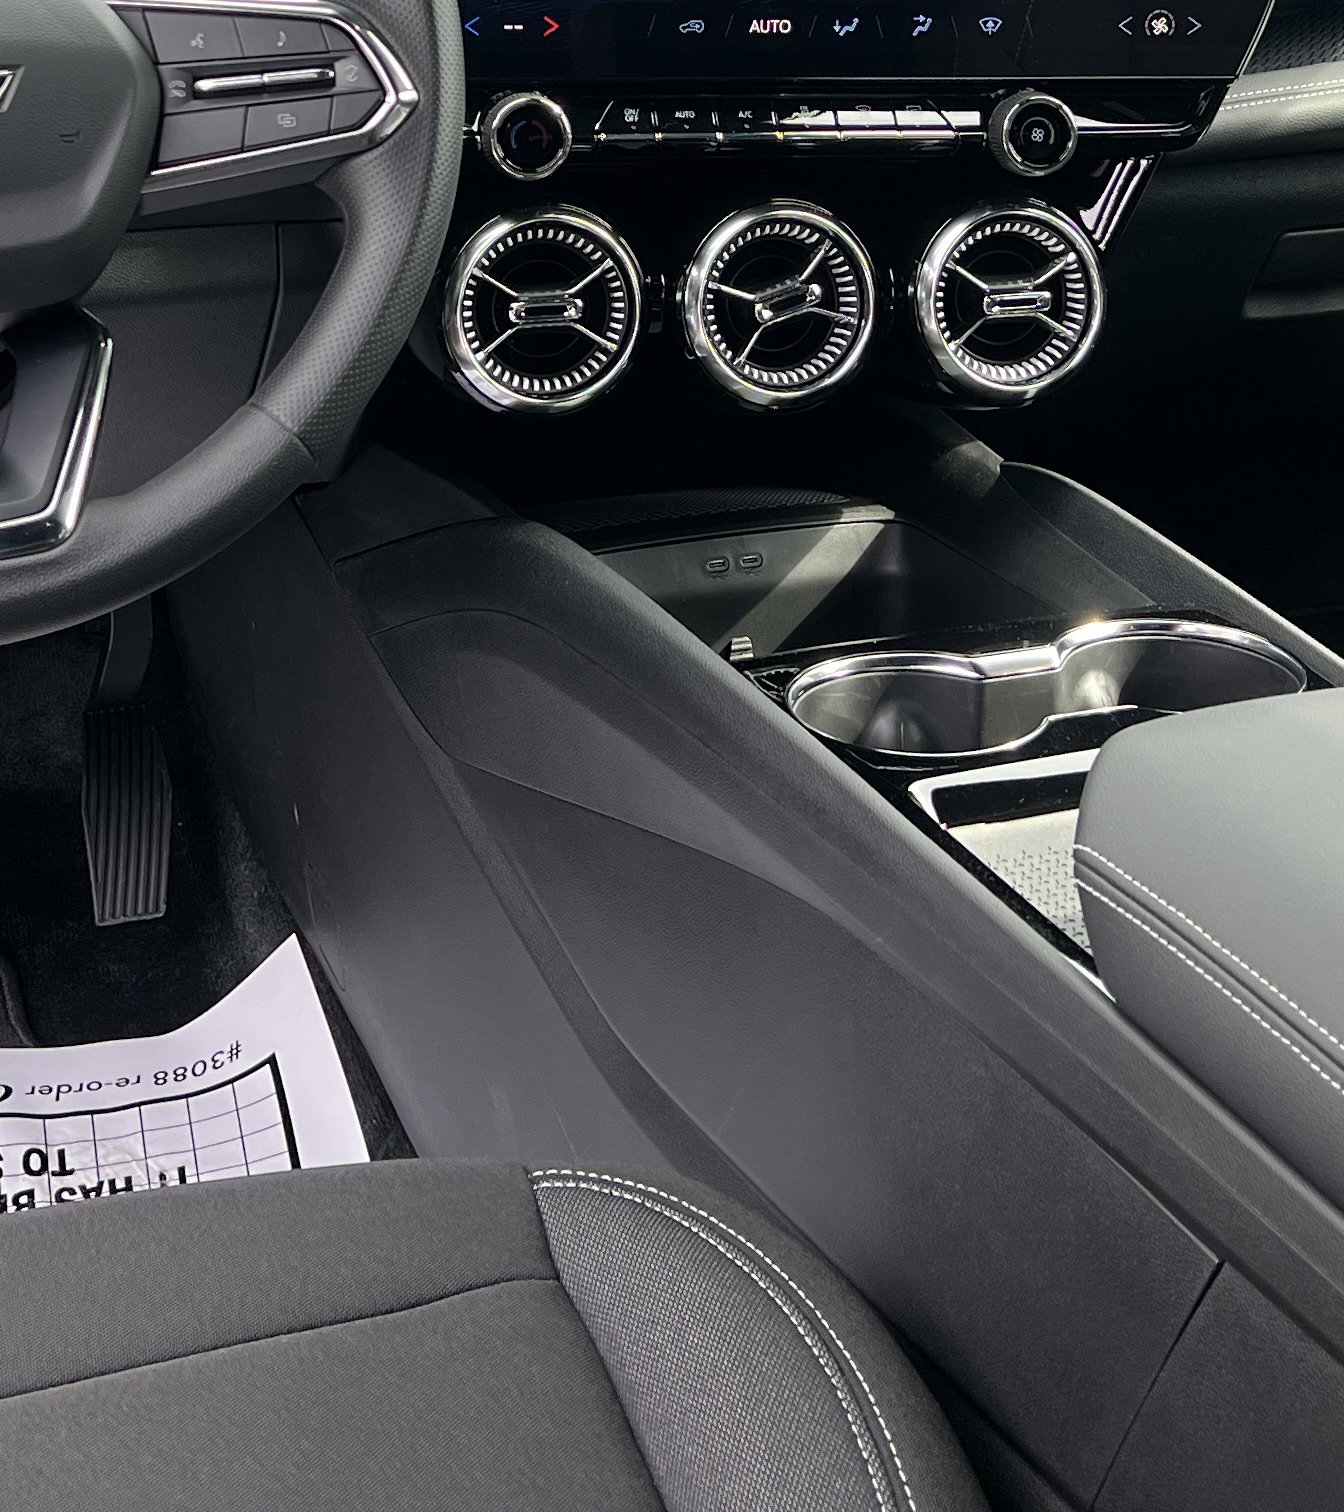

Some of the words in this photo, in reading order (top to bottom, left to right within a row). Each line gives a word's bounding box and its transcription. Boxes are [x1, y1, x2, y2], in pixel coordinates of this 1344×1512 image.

[749, 18, 792, 35] AUTO
[674, 110, 695, 119] AUTO
[738, 110, 753, 119] A/C
[152, 1039, 242, 1087] #3088
[24, 1074, 142, 1102] re-order
[21, 1147, 76, 1178] TO
